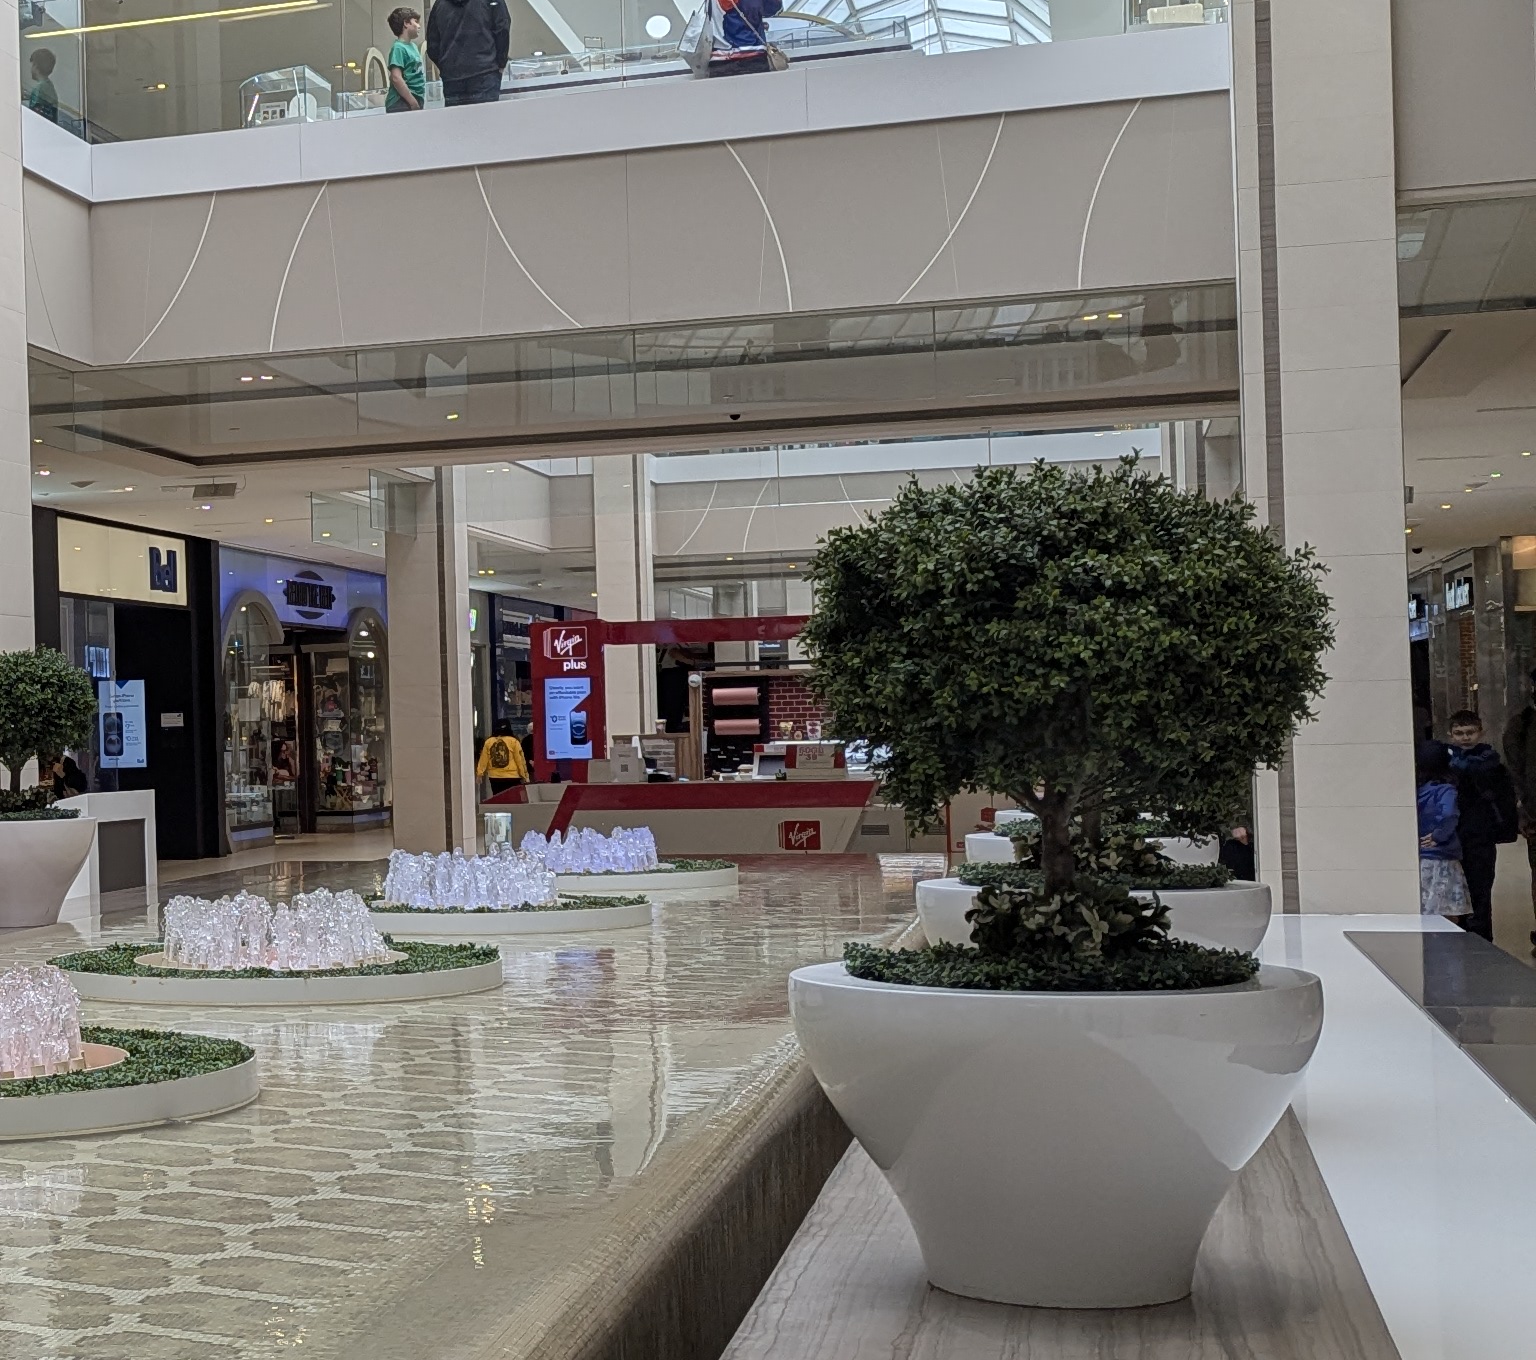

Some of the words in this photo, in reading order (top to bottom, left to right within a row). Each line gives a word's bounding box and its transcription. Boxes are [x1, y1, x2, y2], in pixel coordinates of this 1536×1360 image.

[554, 630, 583, 656] Virgin
[563, 659, 587, 672] plus
[788, 823, 817, 848] Virgin
